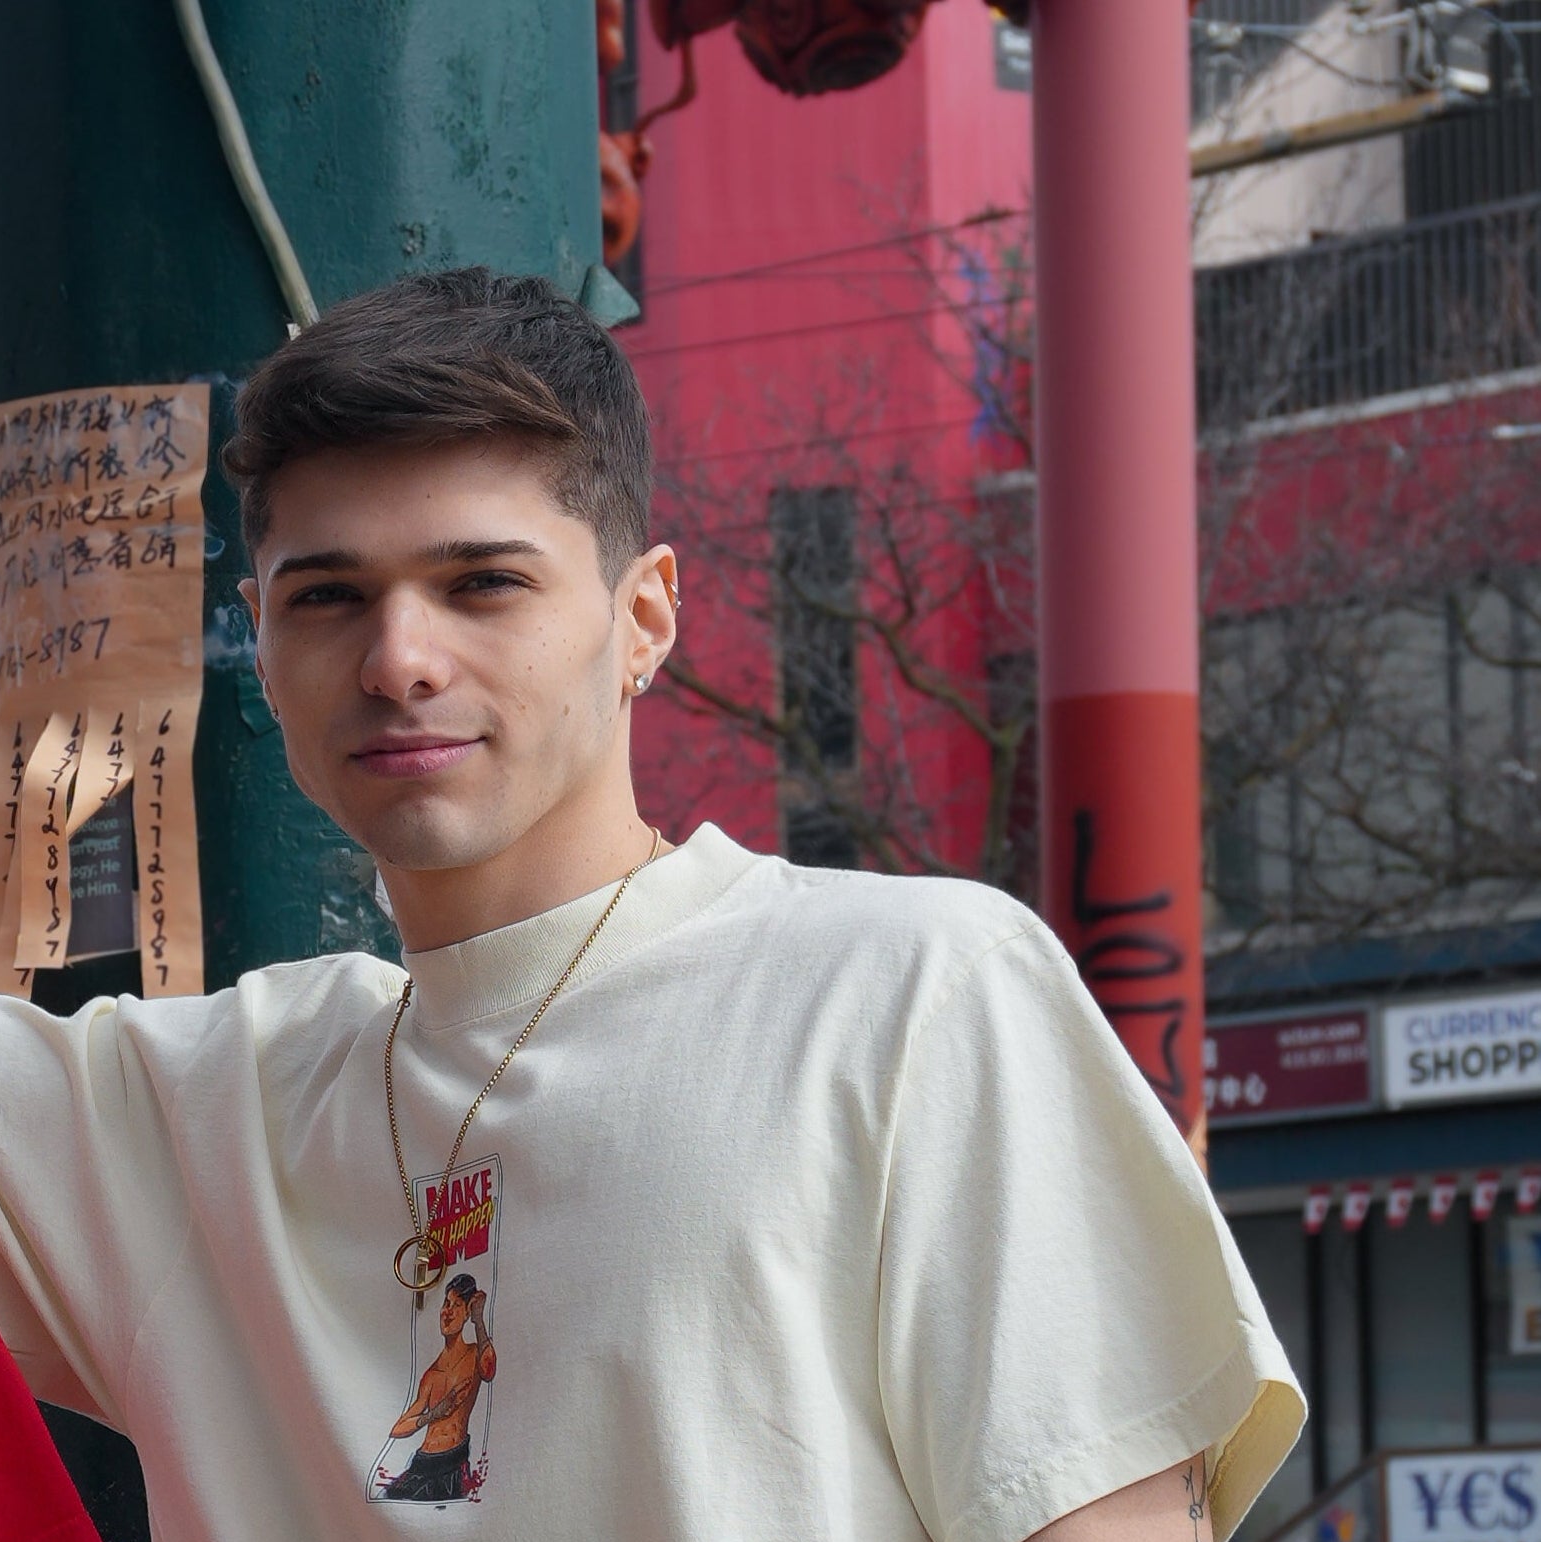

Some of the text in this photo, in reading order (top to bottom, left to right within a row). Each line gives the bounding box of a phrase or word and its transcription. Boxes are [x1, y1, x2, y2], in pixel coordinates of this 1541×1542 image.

[100, 858, 121, 874] He
[426, 1168, 492, 1222] MAKE
[448, 1200, 495, 1249] HAPPEN
